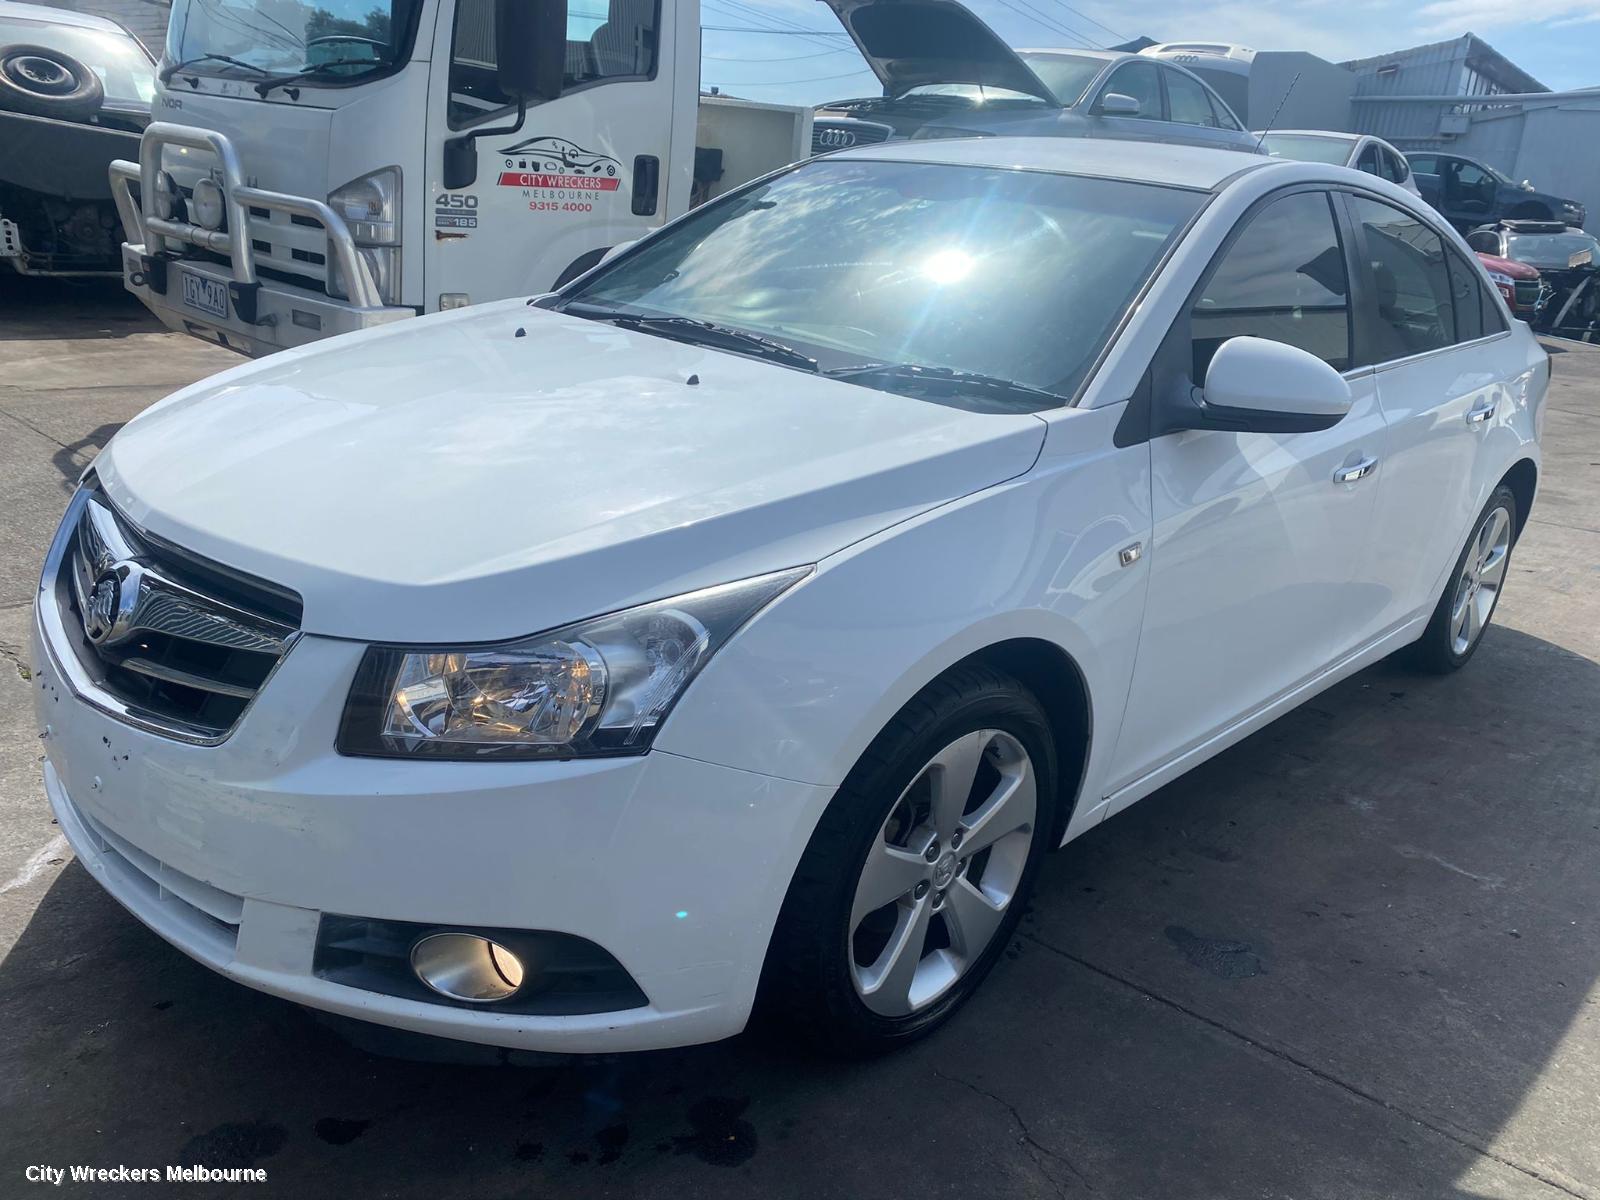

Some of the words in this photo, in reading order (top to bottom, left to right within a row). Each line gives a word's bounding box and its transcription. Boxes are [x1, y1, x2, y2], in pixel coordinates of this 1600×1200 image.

[520, 174, 544, 186] CITY
[546, 175, 601, 189] WRECKERS
[435, 194, 479, 208] 450
[522, 189, 600, 201] MELBOURNE
[529, 201, 559, 211] 9315
[562, 202, 593, 212] 4000
[453, 218, 476, 227] 185
